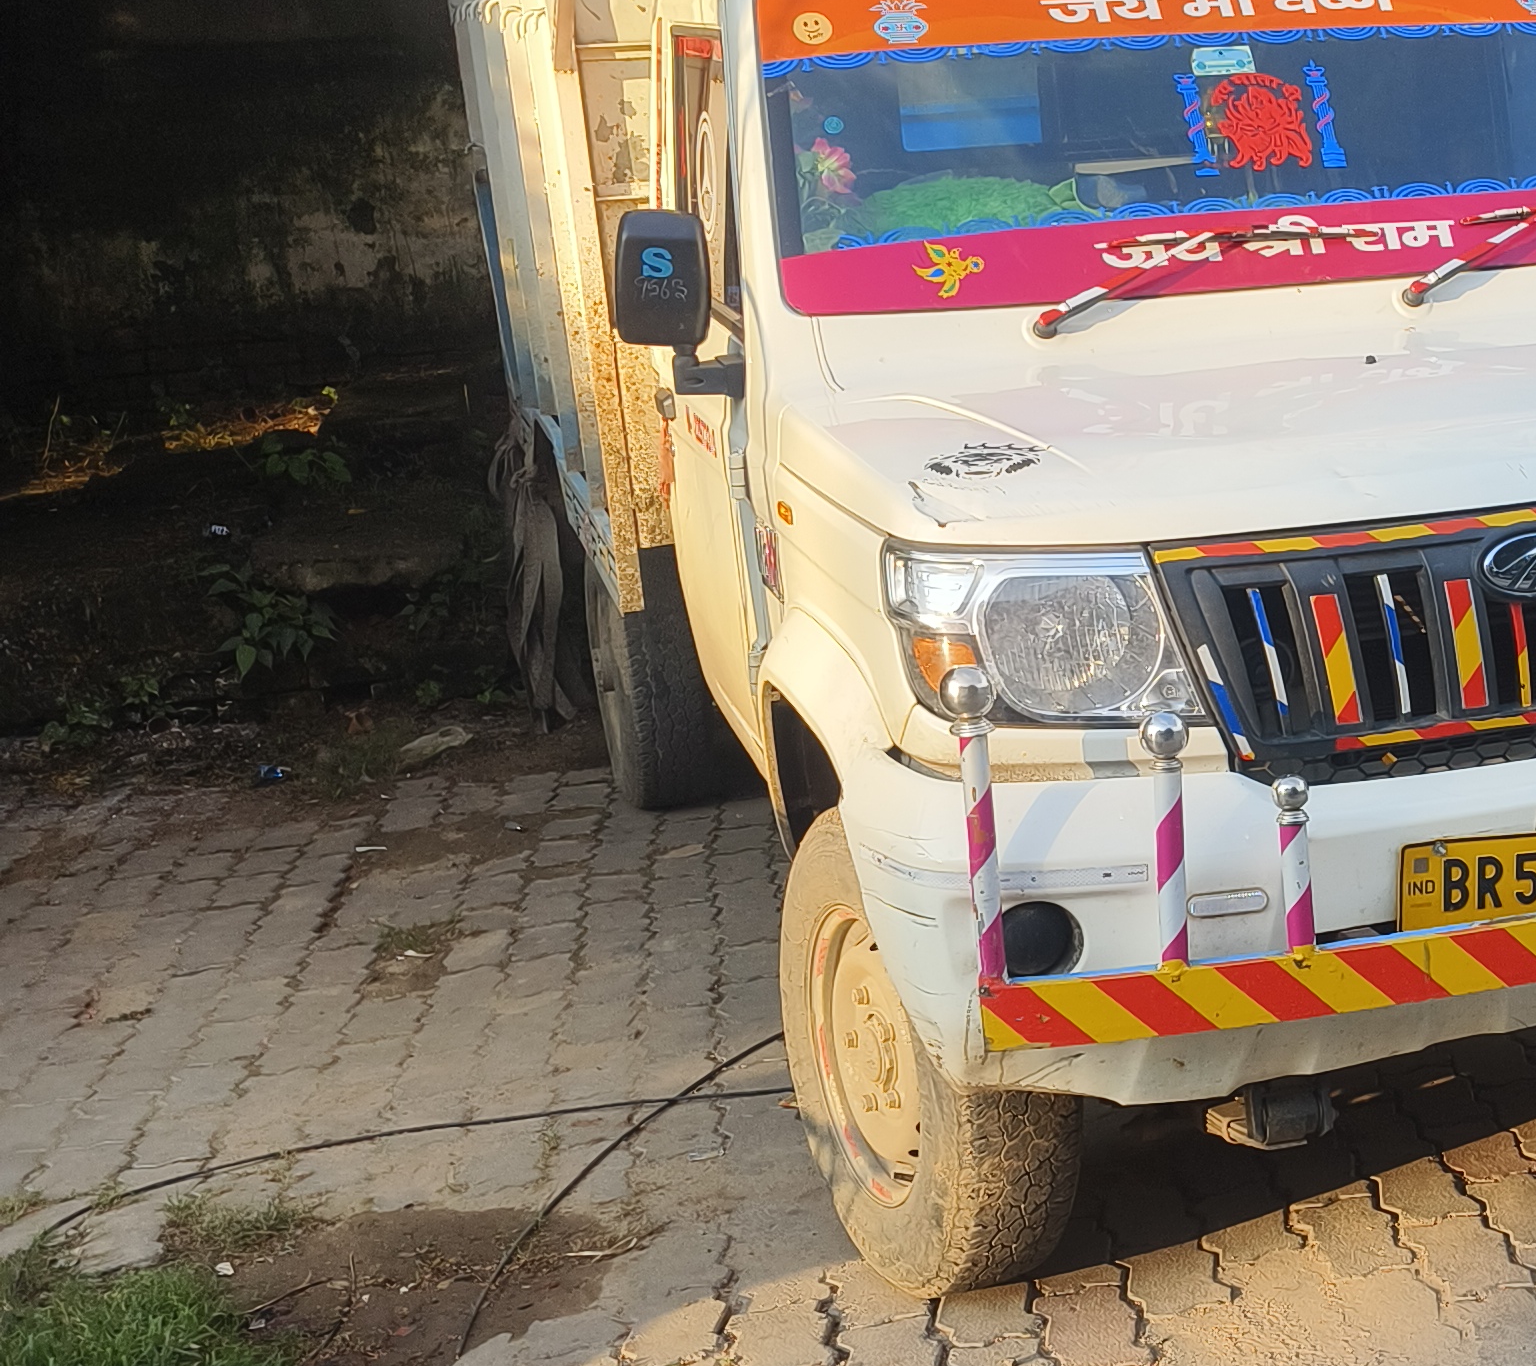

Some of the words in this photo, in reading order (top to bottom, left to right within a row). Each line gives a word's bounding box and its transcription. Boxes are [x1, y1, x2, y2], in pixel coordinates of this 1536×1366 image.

[1342, 220, 1455, 252] राम
[642, 247, 673, 277] S
[1408, 880, 1435, 896] IND
